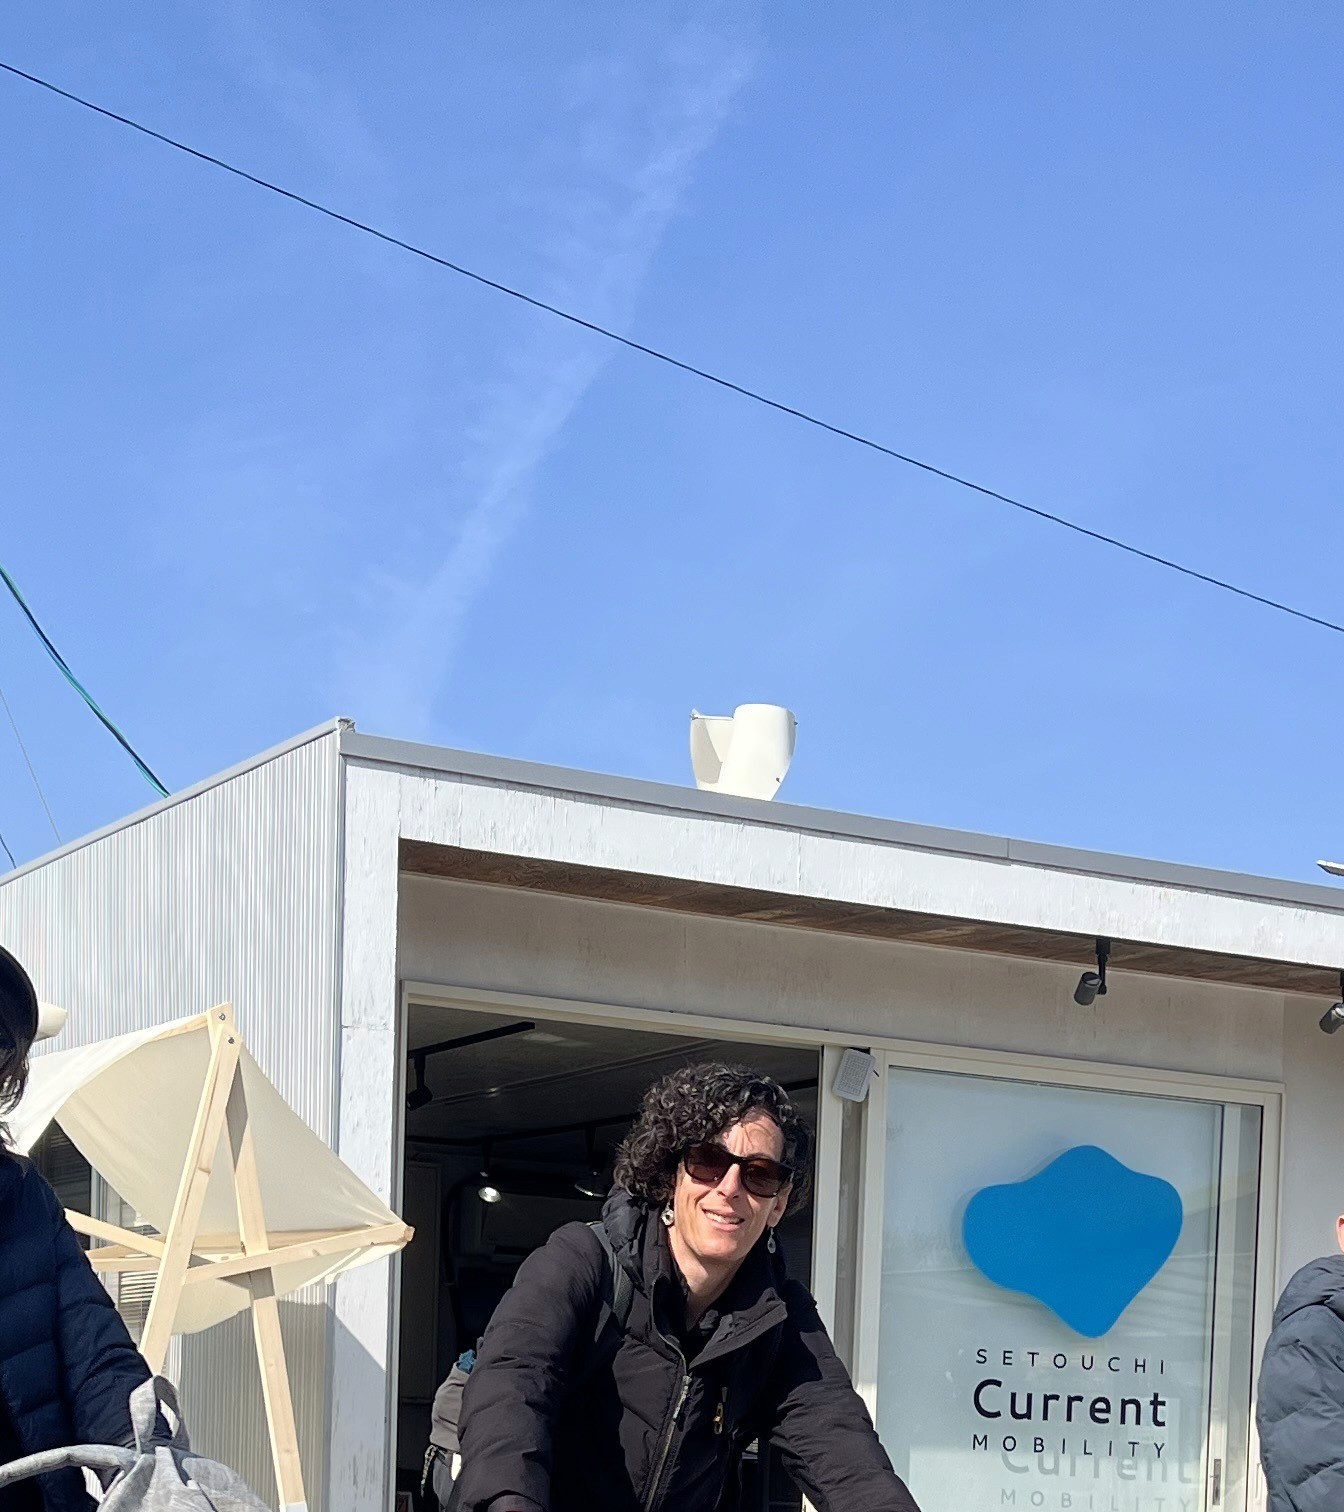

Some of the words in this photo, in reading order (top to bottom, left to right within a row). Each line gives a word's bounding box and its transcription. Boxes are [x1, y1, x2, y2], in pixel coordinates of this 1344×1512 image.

[975, 1348, 1165, 1375] SETOUCHI
[972, 1378, 1167, 1428] Current
[972, 1434, 1166, 1459] MOBILITY
